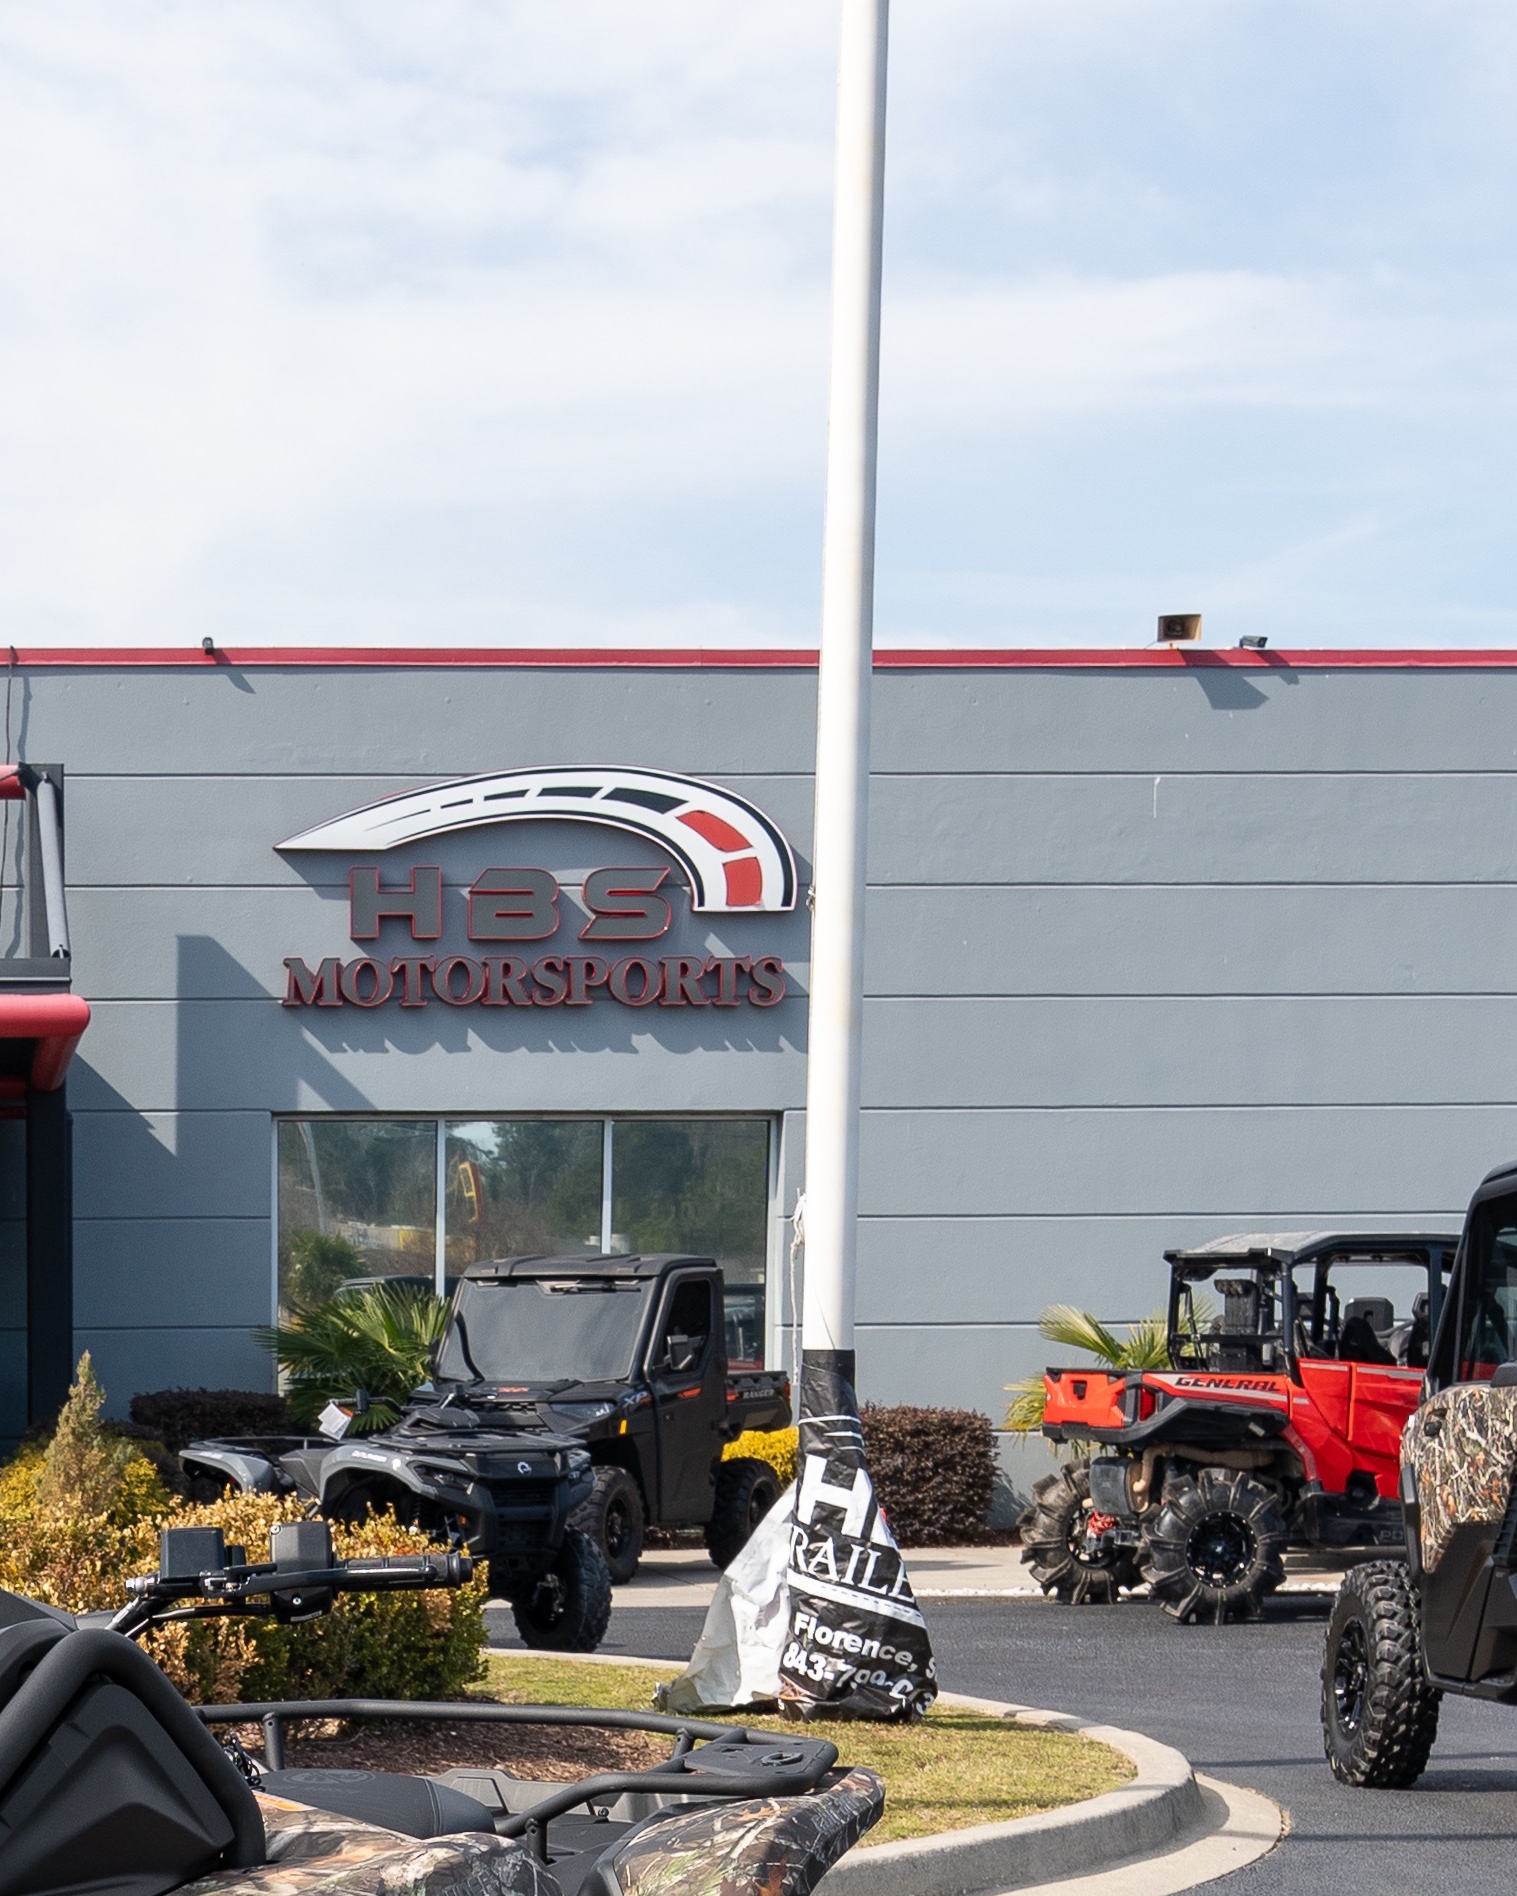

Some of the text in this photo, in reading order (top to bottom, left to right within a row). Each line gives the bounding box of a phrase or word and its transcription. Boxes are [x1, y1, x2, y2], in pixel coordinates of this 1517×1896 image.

[350, 866, 672, 940] HBS
[283, 955, 786, 1008] MOTORSPORTS
[1175, 1377, 1281, 1392] GENERAL
[794, 1611, 919, 1673] Florence,
